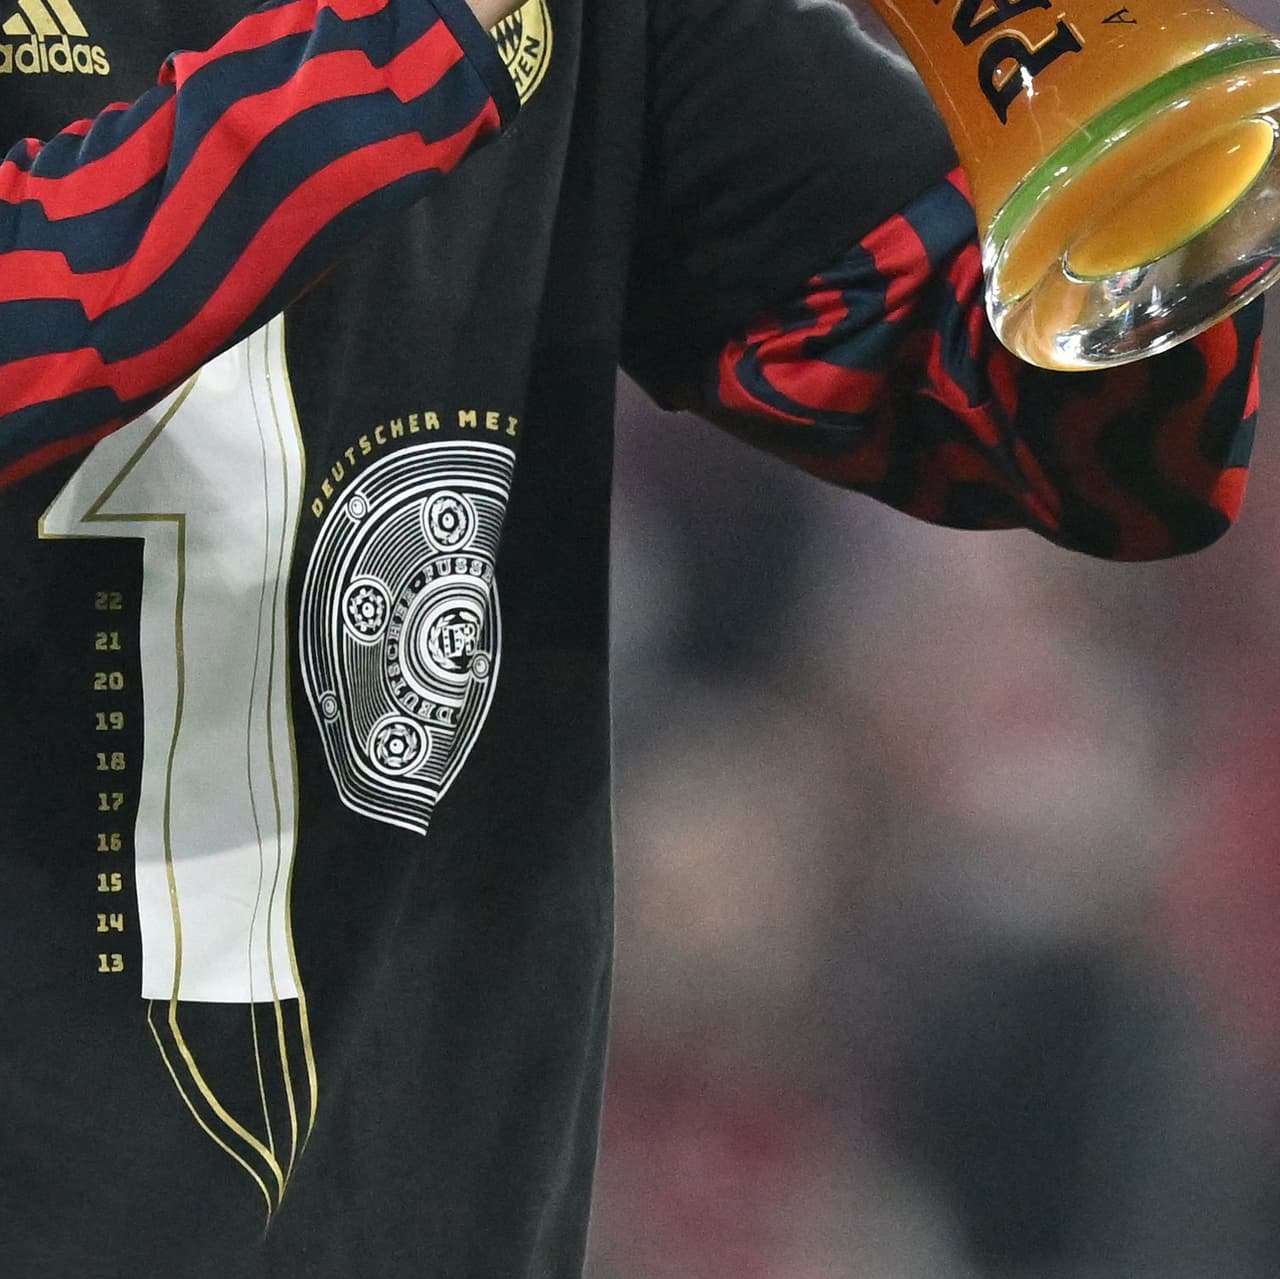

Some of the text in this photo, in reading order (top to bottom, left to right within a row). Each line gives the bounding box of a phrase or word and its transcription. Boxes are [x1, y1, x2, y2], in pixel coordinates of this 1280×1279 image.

[311, 410, 441, 519] DEUTSCHER
[94, 591, 123, 610] 22
[95, 631, 121, 650] 21
[93, 671, 124, 690] 20
[95, 711, 125, 731] 19
[96, 751, 126, 771] 18
[97, 793, 124, 811] 17
[96, 833, 122, 852] 16
[97, 873, 123, 892] 15
[96, 913, 124, 933] 14
[97, 953, 125, 973] 13
